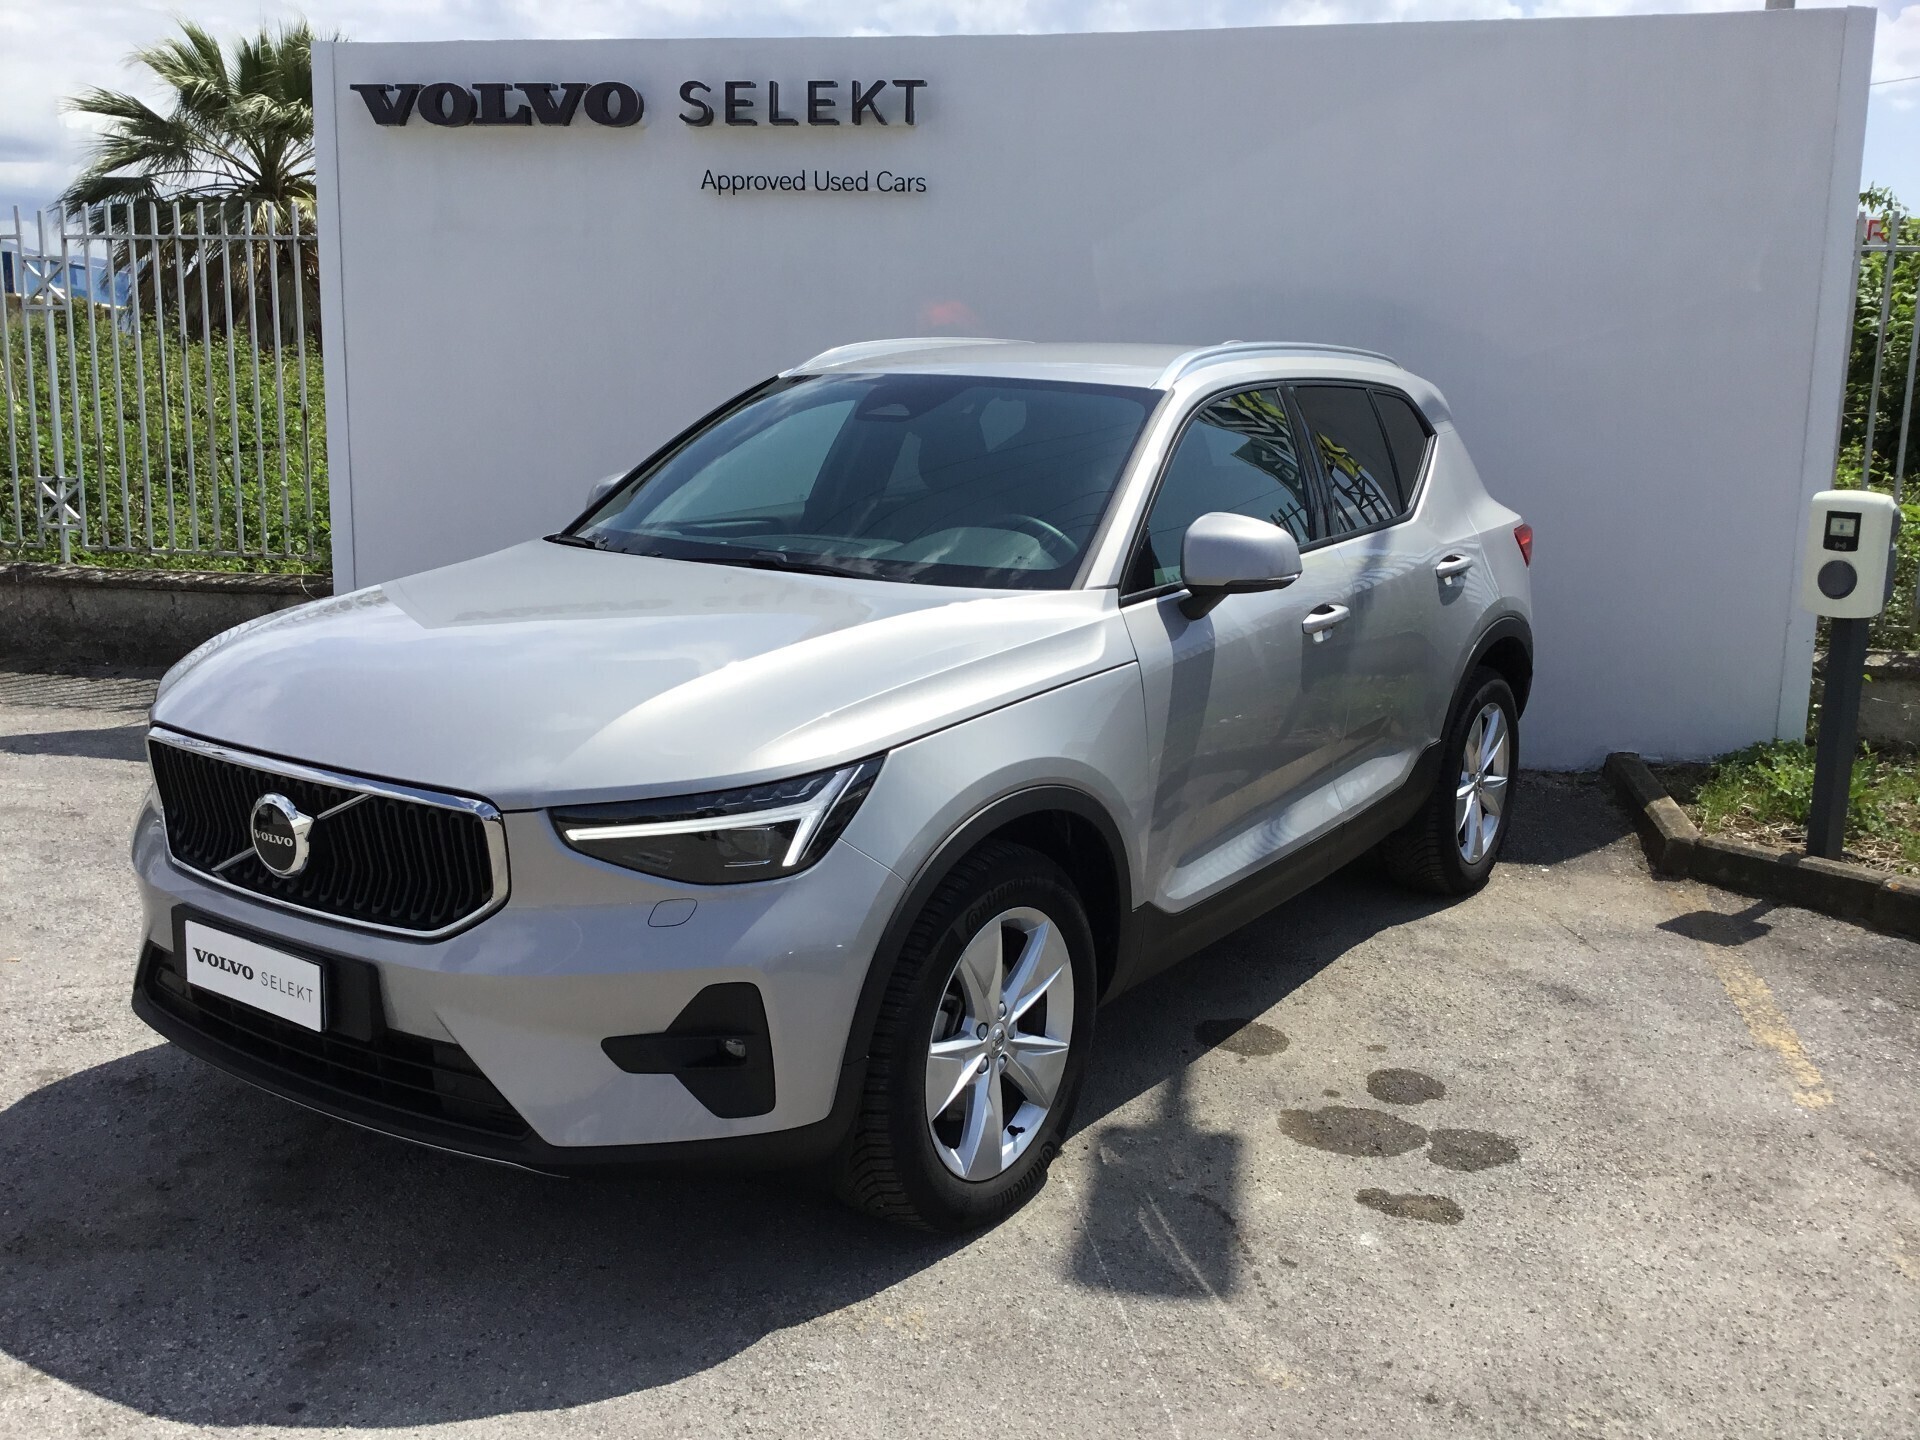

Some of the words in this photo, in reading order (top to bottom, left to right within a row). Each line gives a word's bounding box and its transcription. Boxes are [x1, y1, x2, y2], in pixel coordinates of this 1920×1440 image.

[350, 81, 645, 128] VOLVO
[679, 80, 928, 127] SELEKT
[701, 170, 806, 195] Approved
[814, 170, 869, 192] Used
[876, 171, 927, 192] Cars
[254, 829, 294, 847] VOLVO
[193, 947, 254, 980] VOLVO
[261, 971, 313, 1003] SELEKT
